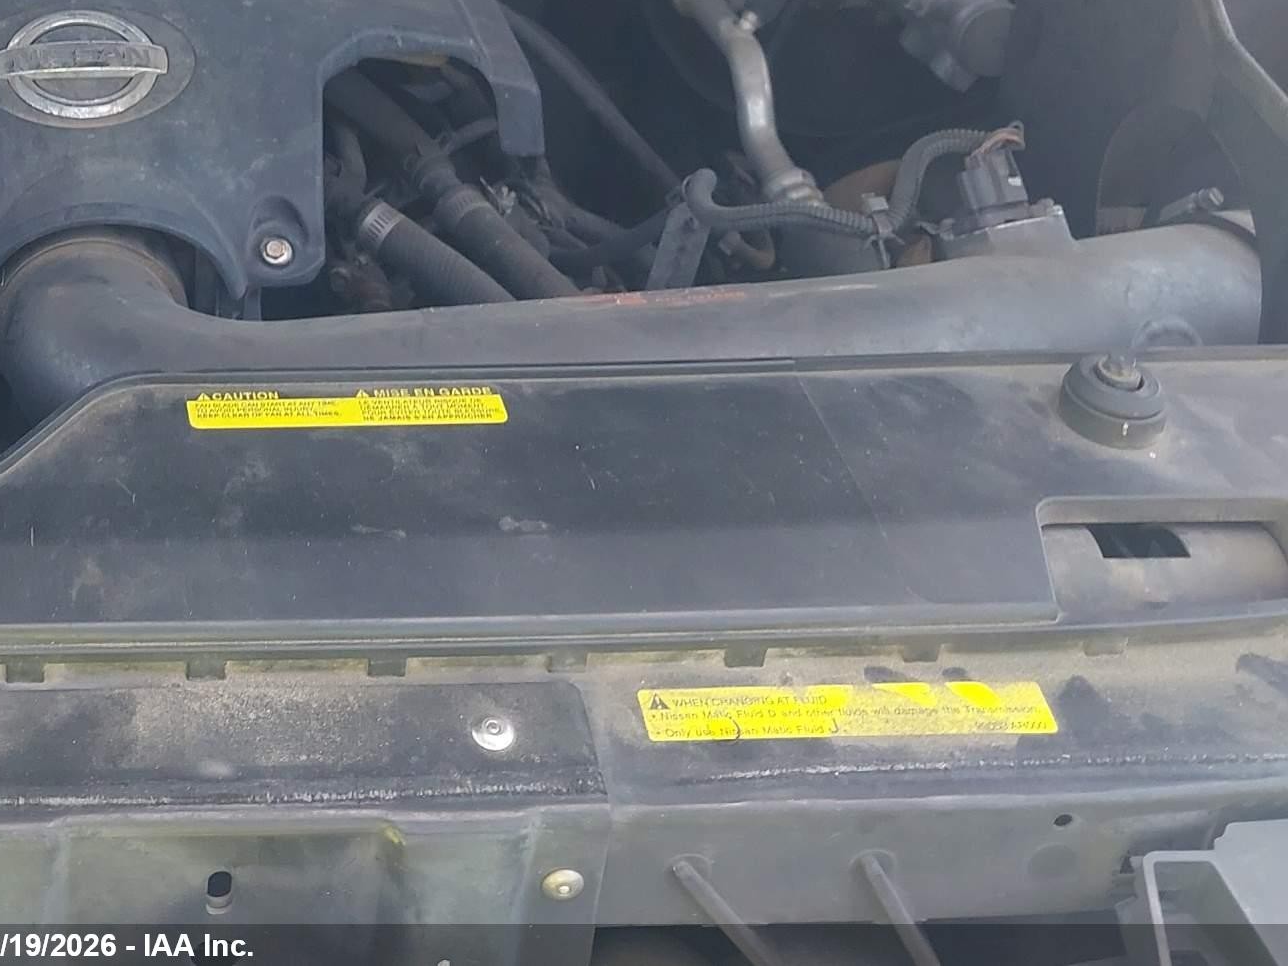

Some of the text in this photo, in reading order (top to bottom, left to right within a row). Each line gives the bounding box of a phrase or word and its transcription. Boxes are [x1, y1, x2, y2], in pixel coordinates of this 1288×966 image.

[212, 390, 279, 401] CAUTION
[373, 386, 492, 398] MISE EN GARDE
[777, 696, 790, 705] AT
